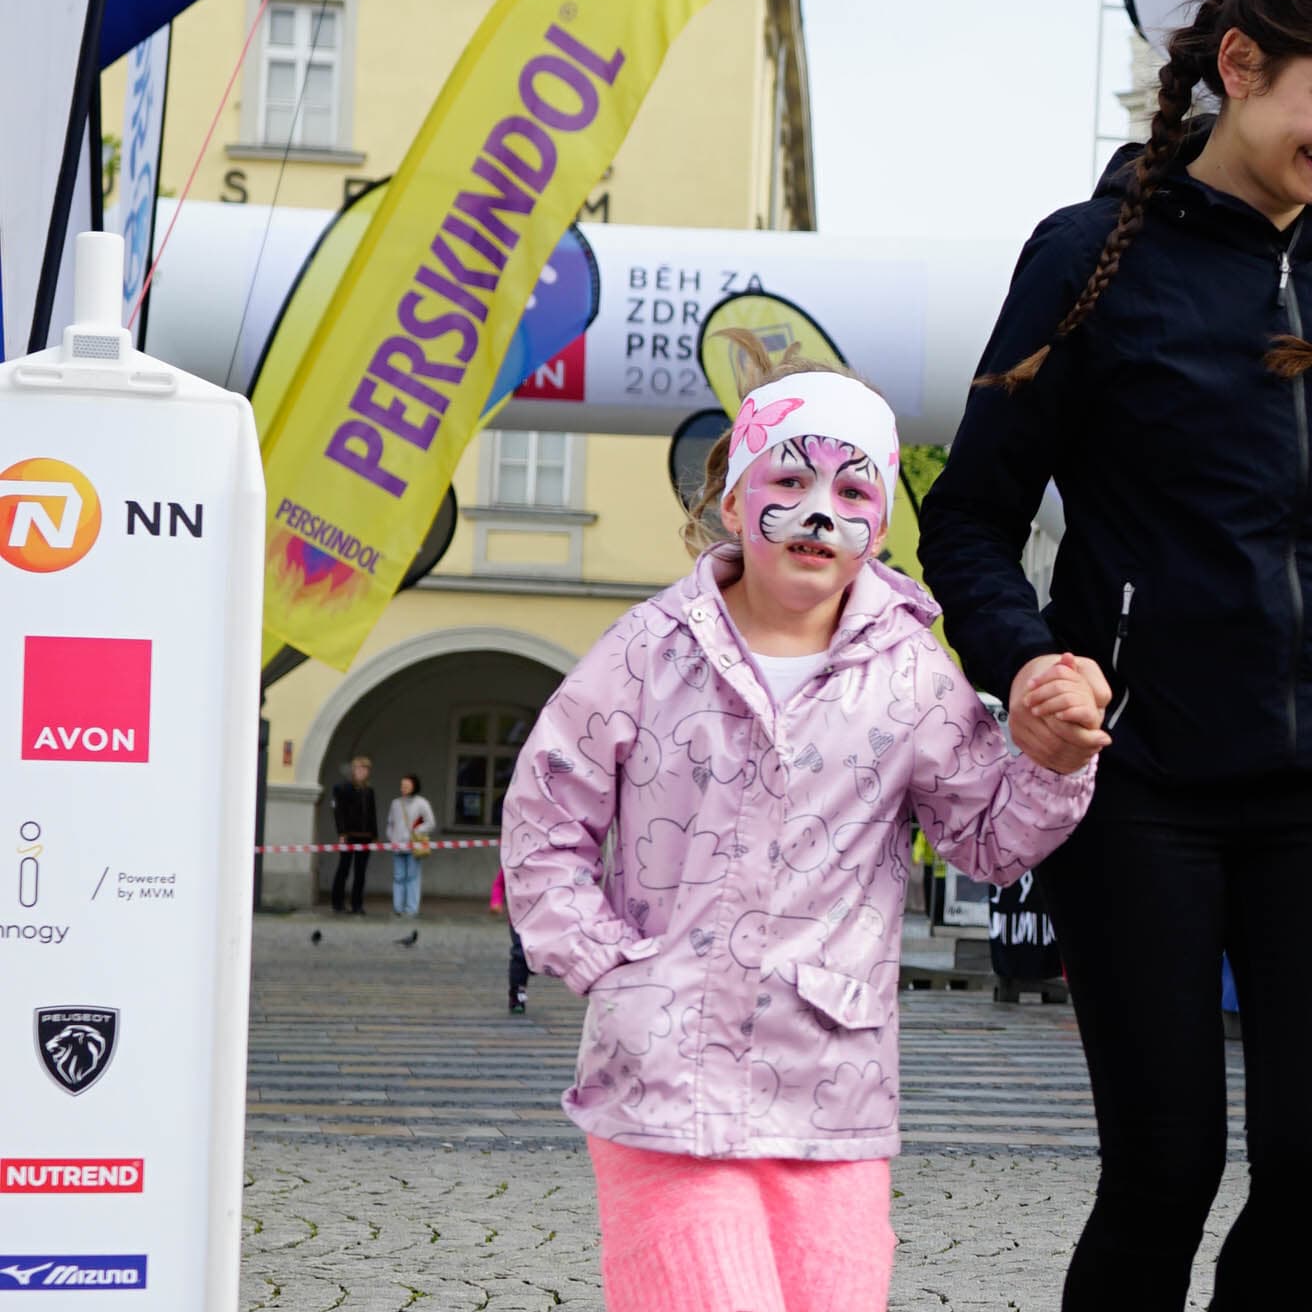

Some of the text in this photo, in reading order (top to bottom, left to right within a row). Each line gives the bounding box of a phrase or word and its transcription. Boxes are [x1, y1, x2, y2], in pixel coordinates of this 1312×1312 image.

[629, 264, 701, 290] BĚH
[626, 297, 701, 326] ZDR
[625, 334, 693, 361] PRS
[625, 367, 711, 397] 202
[125, 500, 203, 538] NN
[34, 726, 135, 752] AVON
[117, 872, 176, 885] Powered
[117, 888, 175, 901] by MVM
[41, 1012, 113, 1023] PEUGEOT
[6, 1166, 139, 1187] NUTREND
